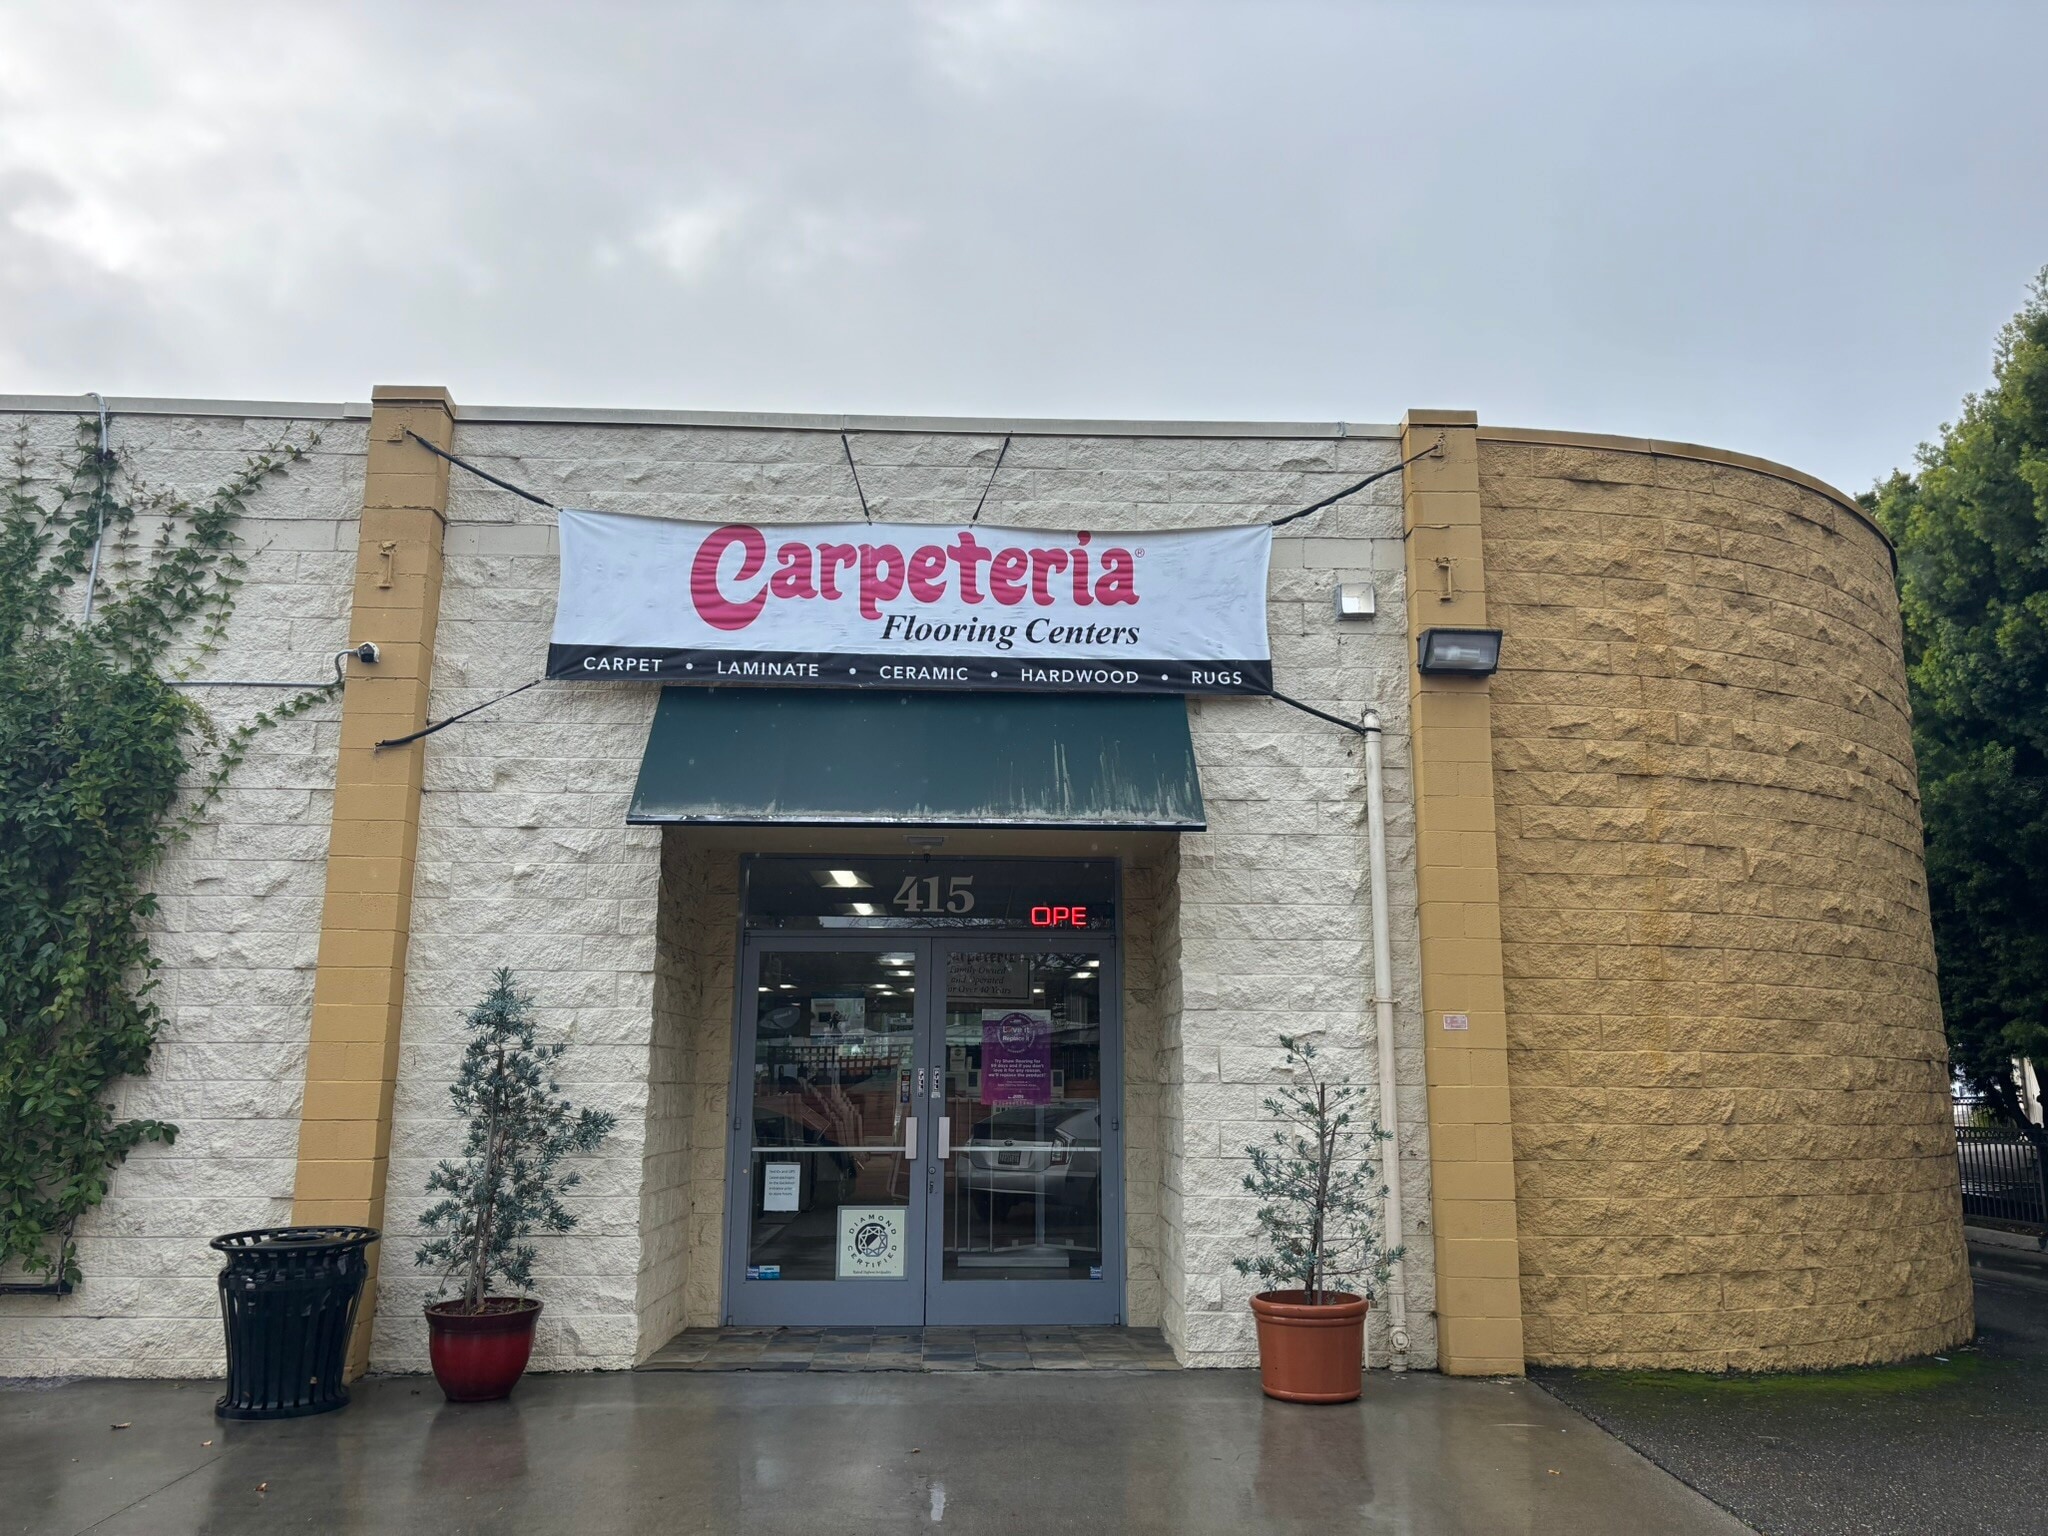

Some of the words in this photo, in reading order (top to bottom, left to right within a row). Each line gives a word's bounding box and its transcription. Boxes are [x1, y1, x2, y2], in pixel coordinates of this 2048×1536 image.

[881, 614, 1017, 650] Flooring
[1025, 617, 1140, 645] Centers
[583, 656, 663, 673] CARPET
[717, 660, 819, 678] LAMINATE
[879, 665, 968, 681] CERAMIC
[1021, 668, 1139, 684] HARDWOOD
[1191, 671, 1243, 686] RUGS
[893, 875, 975, 913] 415
[848, 1213, 897, 1235] DIAMOND
[847, 1244, 898, 1269] CERTIFIED
